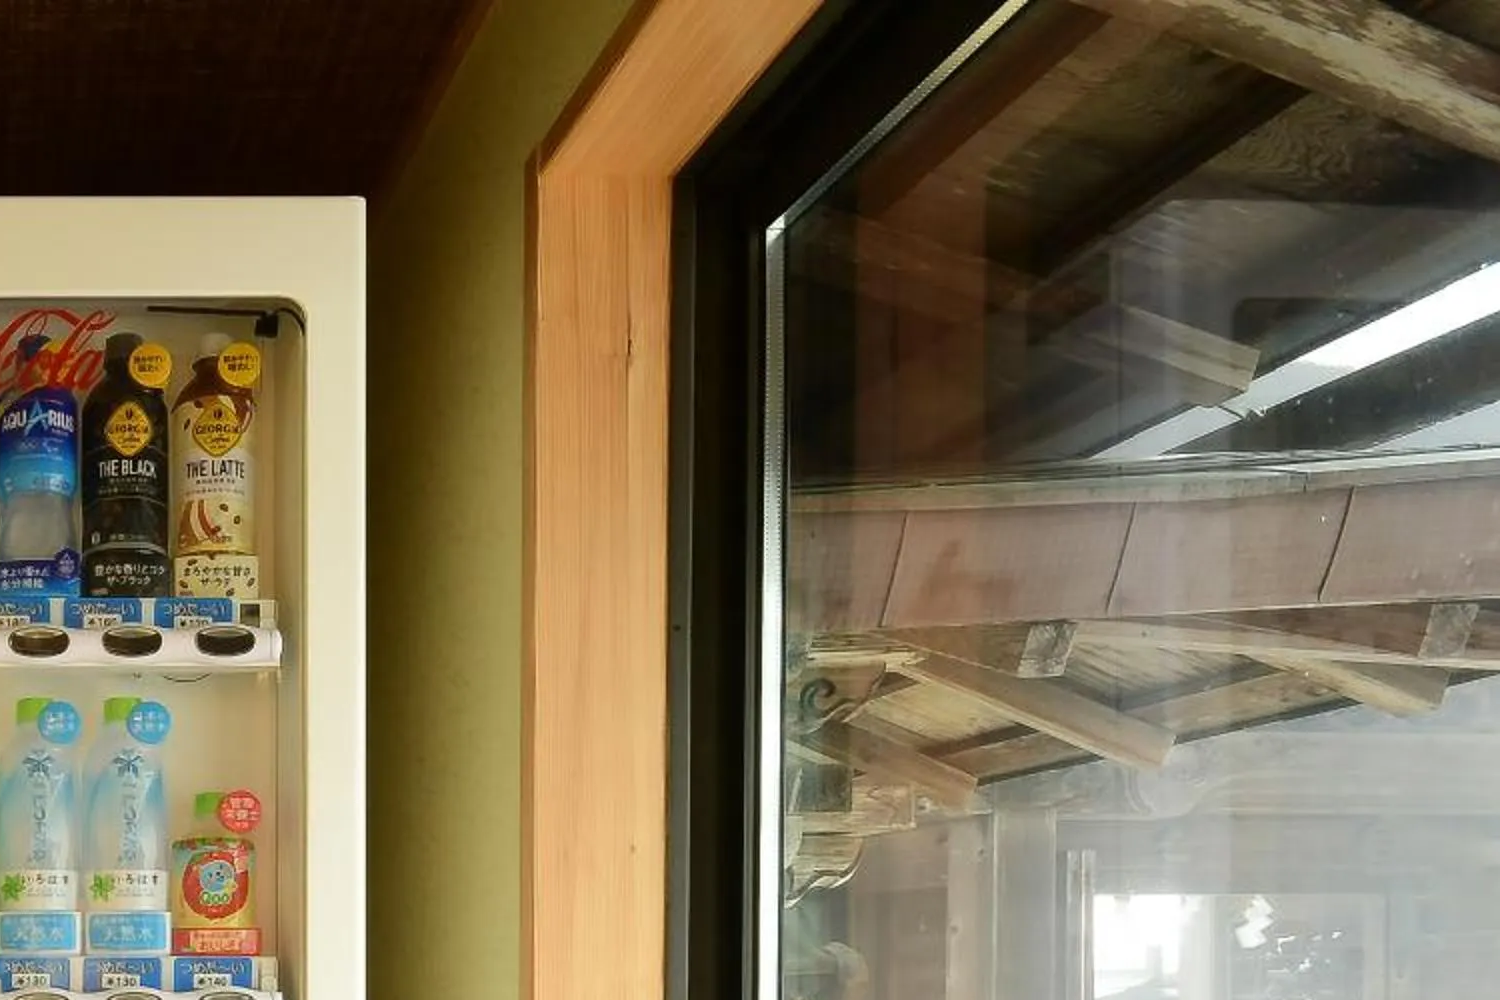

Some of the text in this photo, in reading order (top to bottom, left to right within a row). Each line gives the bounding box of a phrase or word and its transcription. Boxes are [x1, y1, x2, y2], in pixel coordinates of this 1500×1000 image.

[2, 398, 74, 436] AQUARIUS
[99, 459, 157, 478] THE BLACK
[186, 459, 245, 479] THE LATTE
